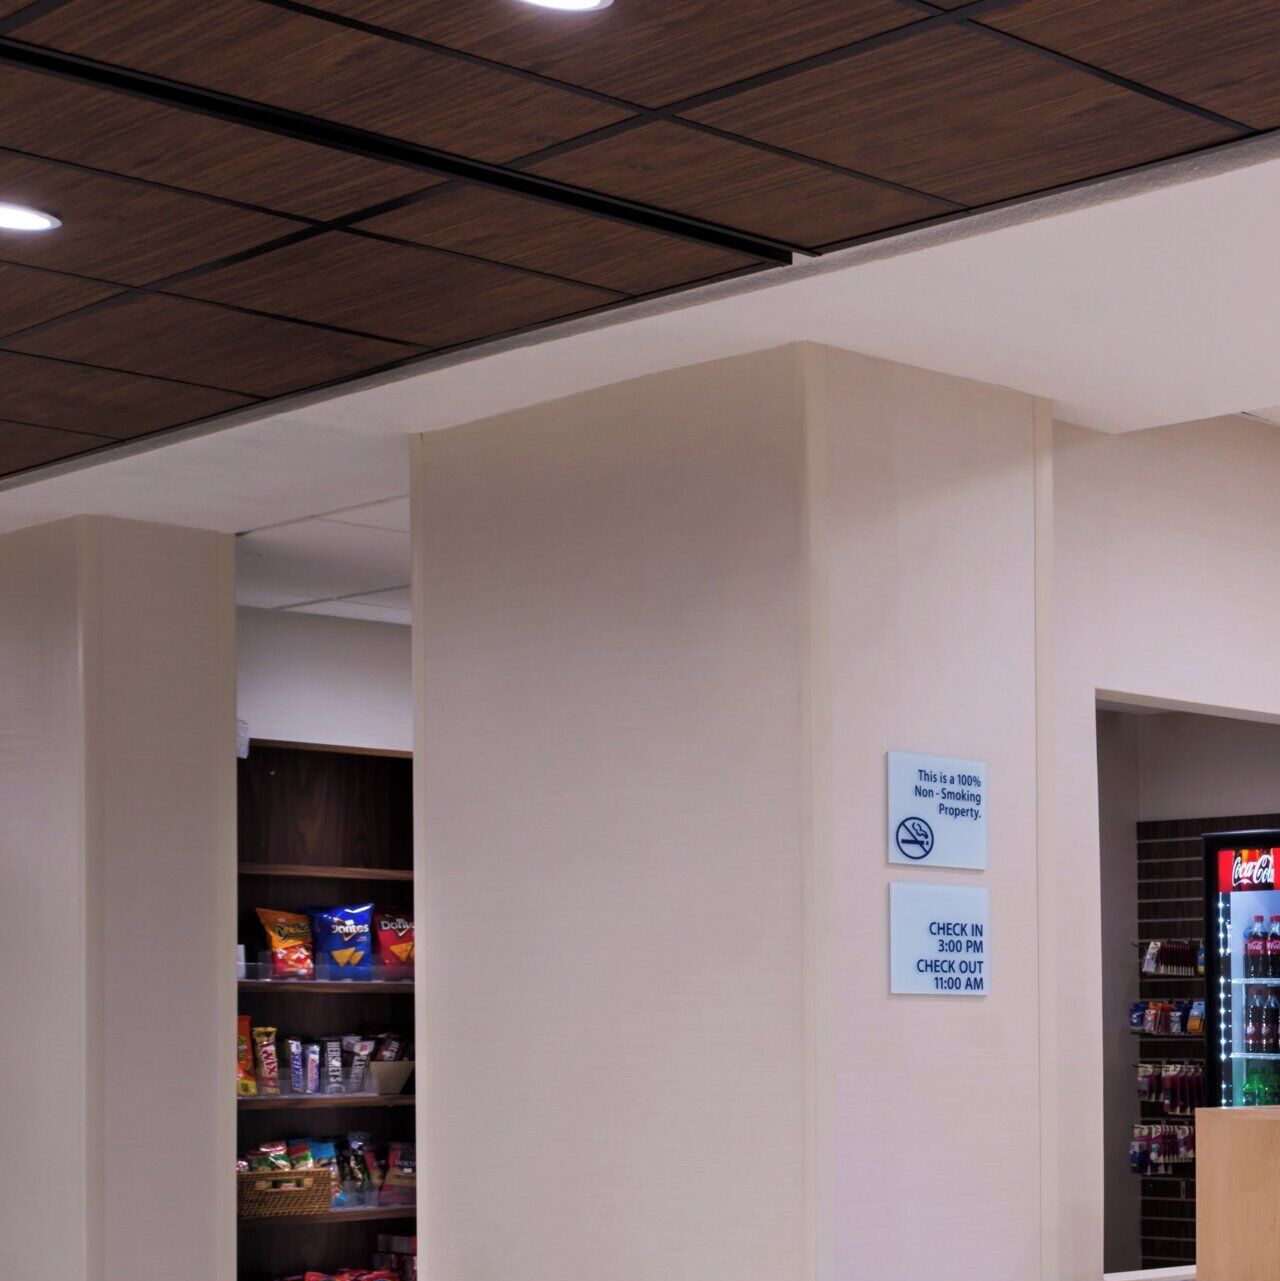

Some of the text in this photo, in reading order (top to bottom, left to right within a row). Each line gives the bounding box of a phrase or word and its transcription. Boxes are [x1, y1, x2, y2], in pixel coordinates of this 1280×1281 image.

[918, 769, 982, 787] This is a 100%
[914, 784, 934, 798] Non
[941, 787, 981, 806] Smoking
[938, 803, 982, 821] Property.
[929, 921, 983, 937] CHECK IN
[938, 938, 984, 953] 3:00 PM
[916, 958, 984, 974] CHECK OUT
[934, 976, 984, 990] 11:00 AM
